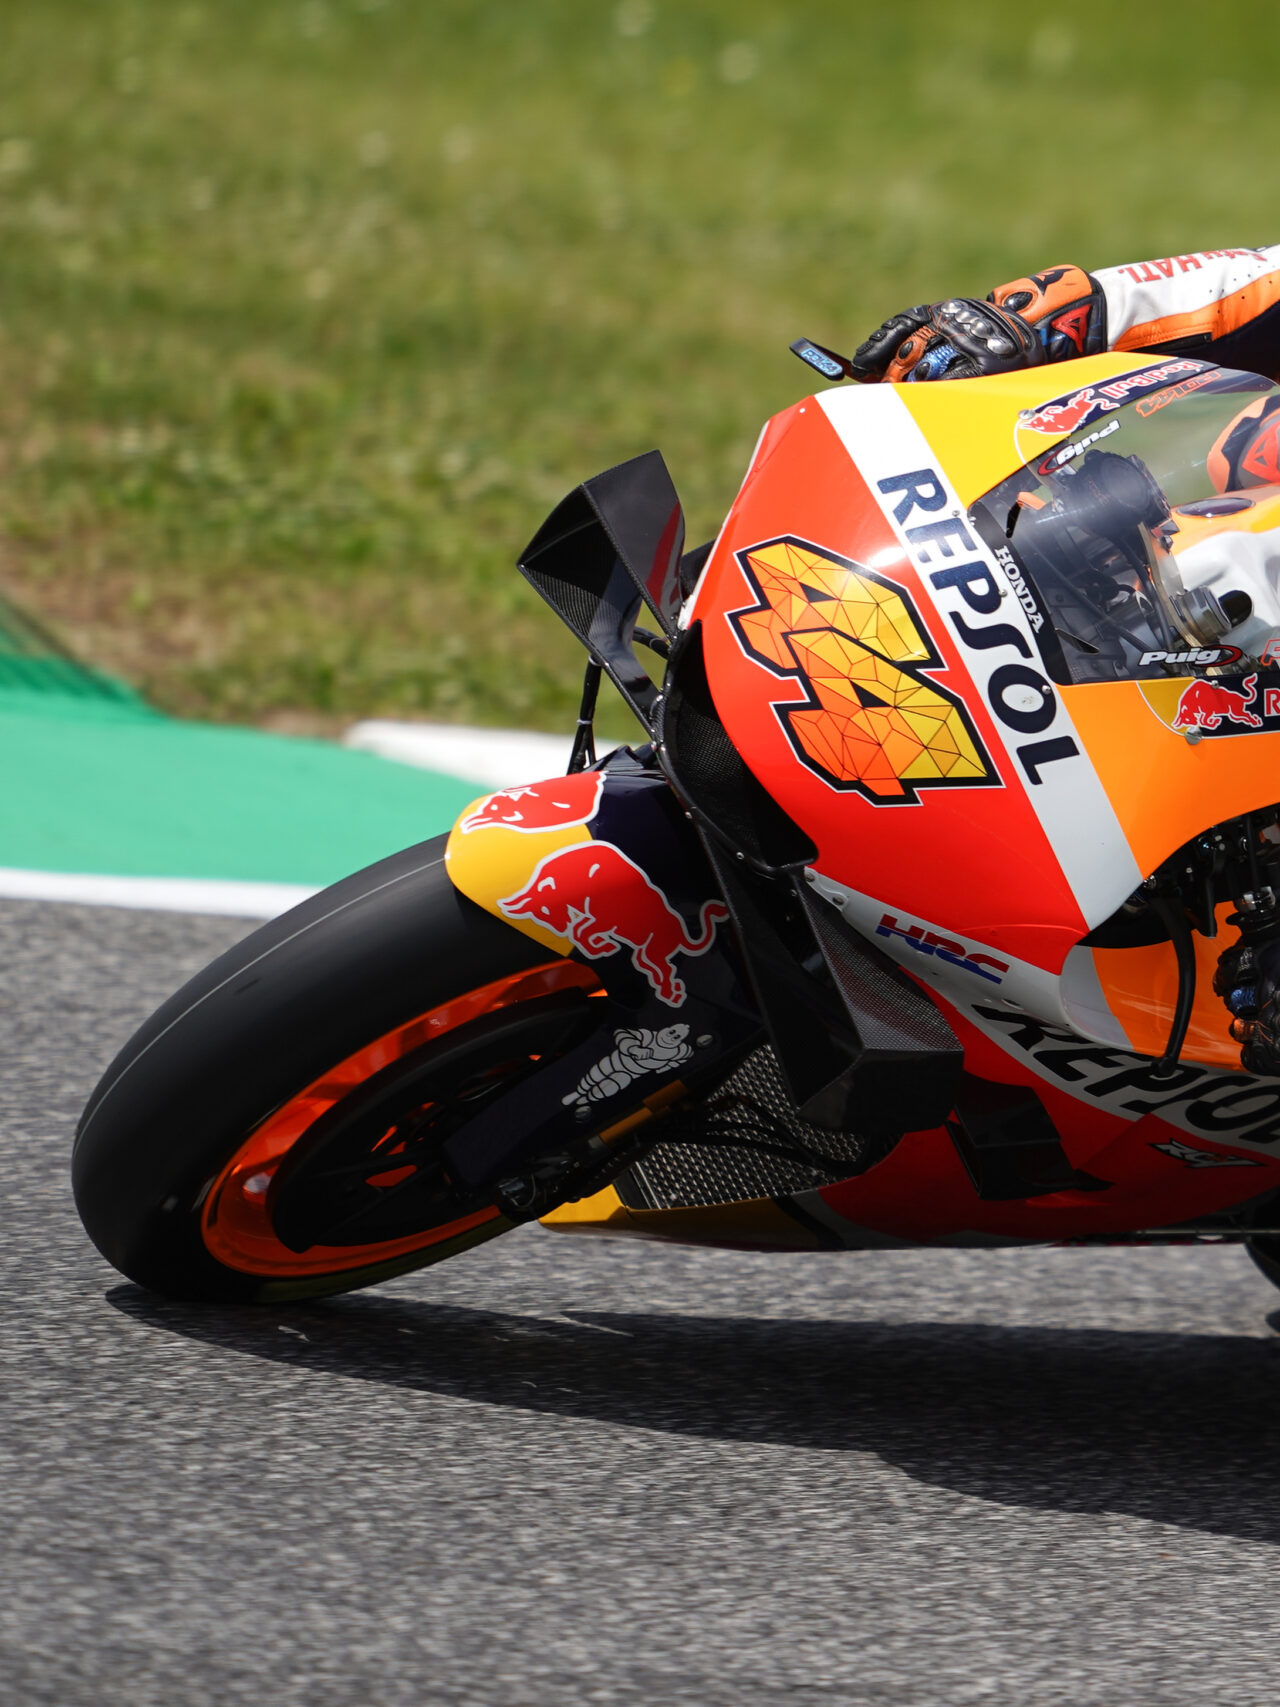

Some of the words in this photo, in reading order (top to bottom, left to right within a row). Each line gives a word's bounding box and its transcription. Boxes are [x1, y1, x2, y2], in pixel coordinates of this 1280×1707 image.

[1057, 419, 1121, 465] Puig
[995, 546, 1045, 634] HONDA
[877, 468, 1080, 786] REPSOL
[1139, 648, 1221, 667] Puig
[875, 913, 1011, 985] HRC
